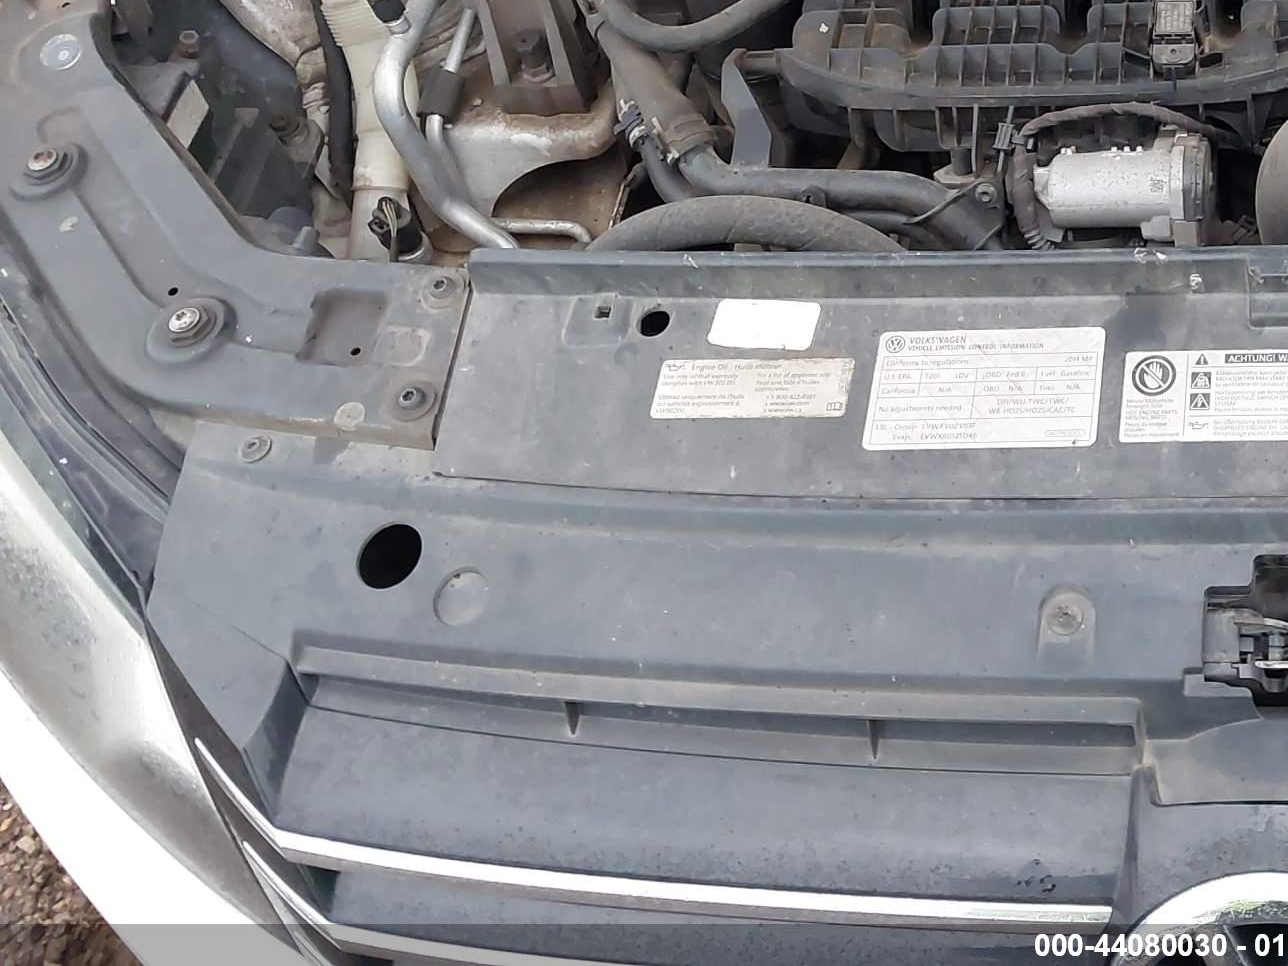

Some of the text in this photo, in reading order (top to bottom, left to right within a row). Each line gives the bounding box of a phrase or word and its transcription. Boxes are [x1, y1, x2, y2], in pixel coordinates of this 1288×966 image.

[908, 335, 967, 345] VOLKSWAGEN
[935, 343, 966, 351] EMISSION
[999, 342, 1045, 350] INFORMATION
[1228, 353, 1276, 363] ACHTUNG!
[691, 362, 728, 372] Engine Oil
